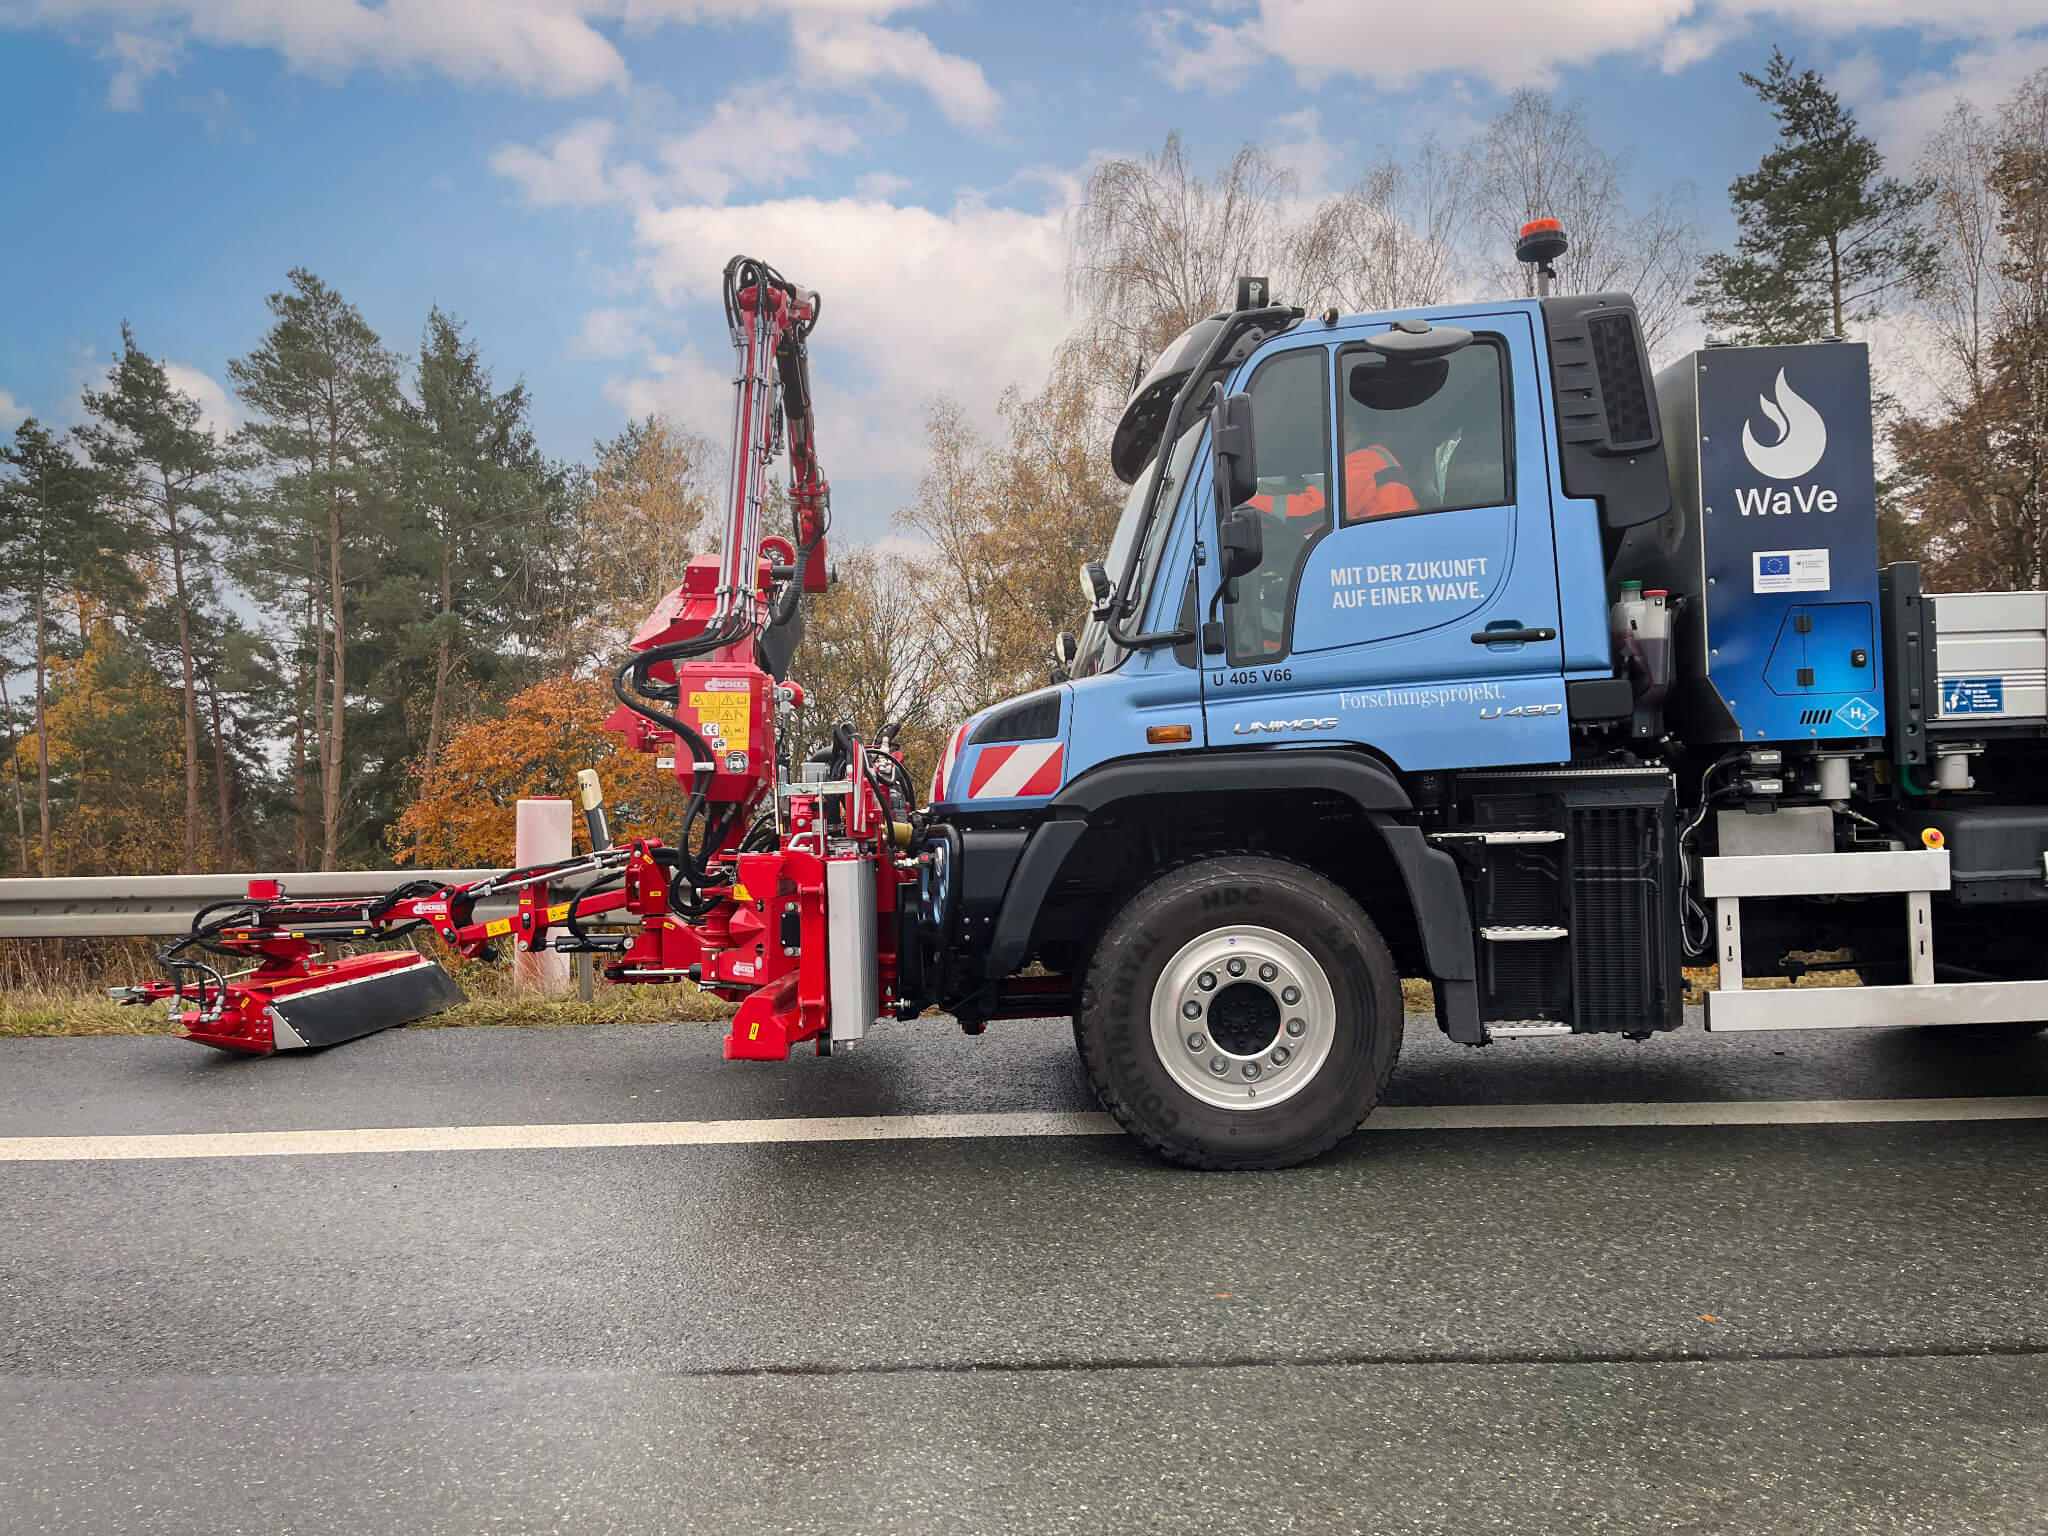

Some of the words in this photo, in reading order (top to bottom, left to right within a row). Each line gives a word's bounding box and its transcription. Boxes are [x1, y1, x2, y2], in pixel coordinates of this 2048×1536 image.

[1735, 485, 1838, 516] WaVe
[1330, 567, 1362, 586] MIT
[1367, 564, 1402, 584] DER
[1406, 558, 1487, 581] ZUKUNFT
[1333, 589, 1367, 609] AUF
[1370, 585, 1423, 607] EINER
[1426, 581, 1485, 602] WAVE.
[1213, 674, 1224, 687] U
[1230, 671, 1257, 685] 405
[1262, 668, 1293, 683] V66
[1340, 683, 1506, 710] Forschungsprojekt.
[1480, 706, 1502, 720] U
[1504, 703, 1563, 718] 430
[1233, 717, 1339, 735] UNIMOG
